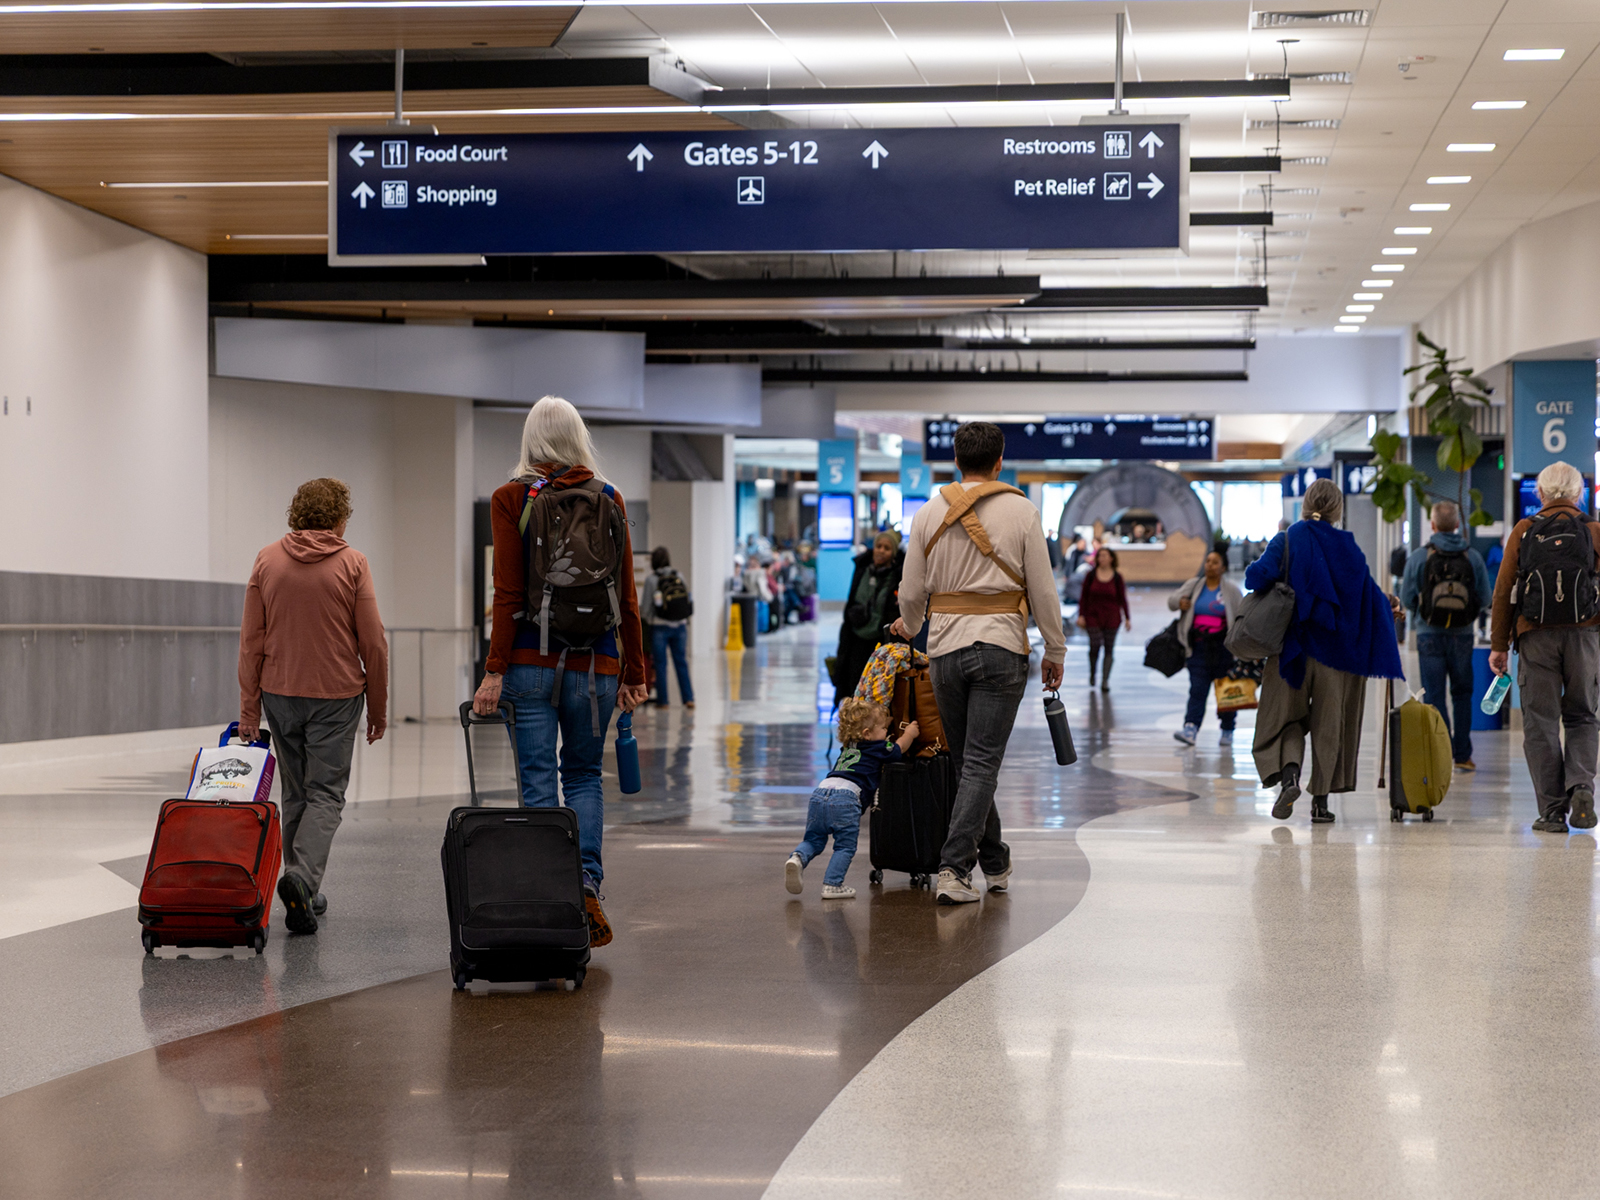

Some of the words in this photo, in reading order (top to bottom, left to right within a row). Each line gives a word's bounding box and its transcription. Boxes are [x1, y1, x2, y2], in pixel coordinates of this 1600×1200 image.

[415, 144, 457, 163] Food
[459, 145, 508, 163] Court
[683, 141, 759, 166] Gates
[763, 140, 819, 165] 5-12
[1003, 138, 1096, 155] Restrooms
[416, 184, 497, 206] Shopping
[1014, 179, 1043, 196] Pet
[1045, 177, 1096, 196] Relief
[1536, 401, 1573, 415] GATE
[1542, 417, 1567, 453] 6
[829, 466, 843, 485] 5
[834, 747, 861, 771] 12
